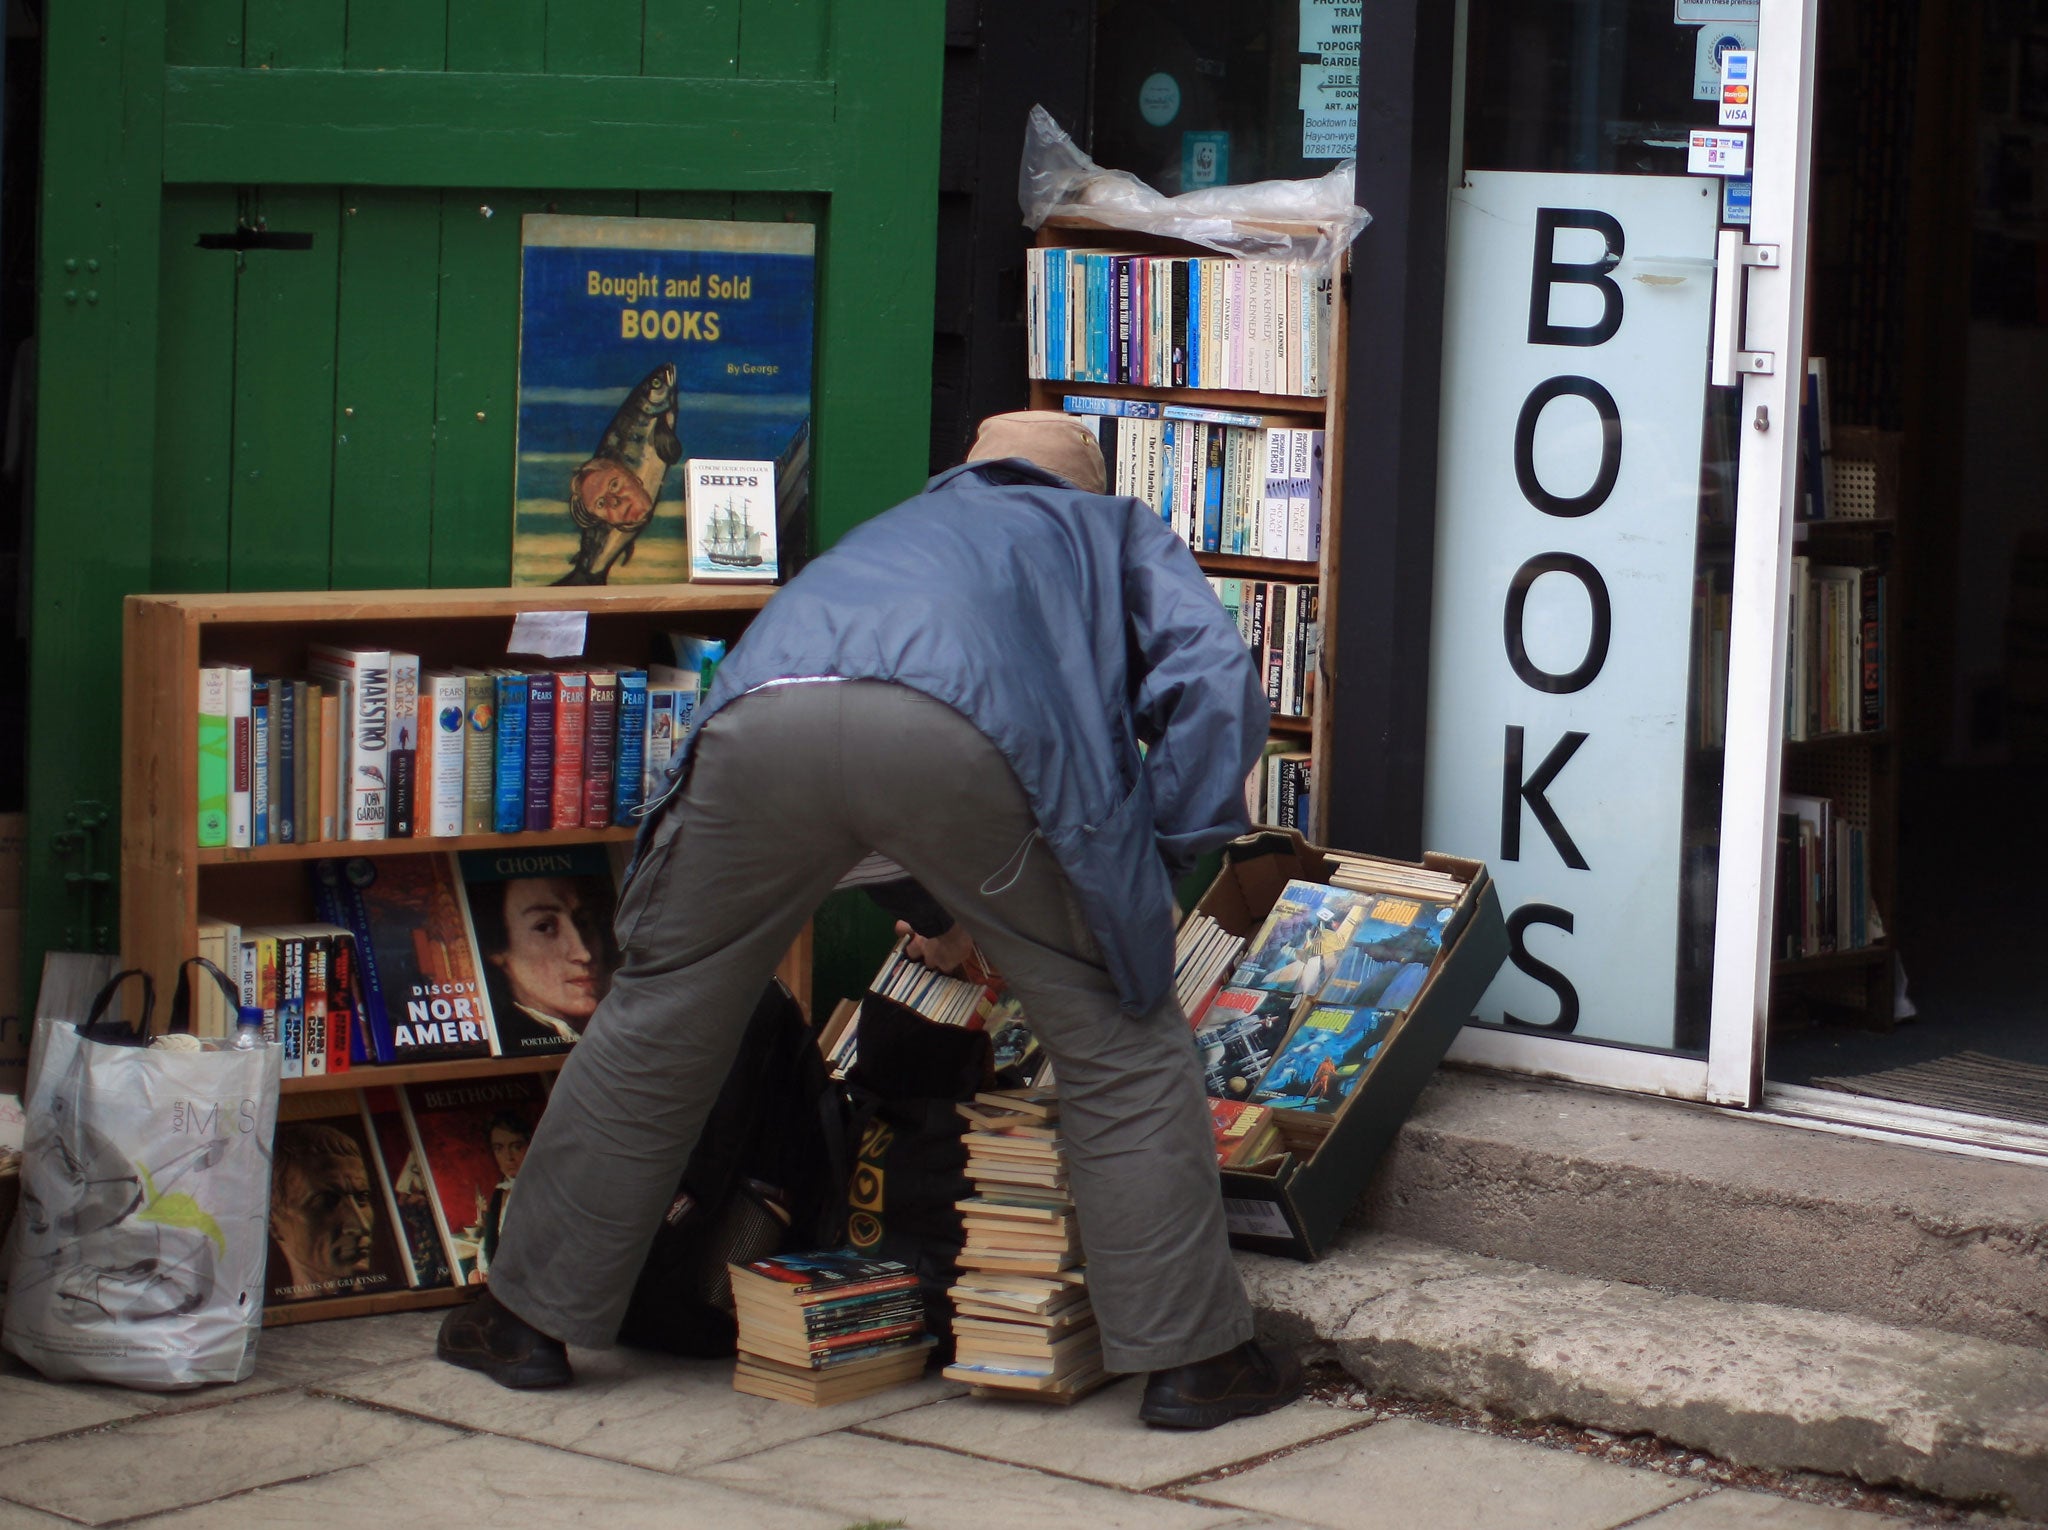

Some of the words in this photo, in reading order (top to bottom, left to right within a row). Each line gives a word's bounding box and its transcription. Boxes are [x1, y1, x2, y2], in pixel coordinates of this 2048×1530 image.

[1327, 75, 1351, 84] SIDE
[1305, 117, 1347, 128] Booktown
[1725, 109, 1747, 119] VISA
[1305, 132, 1355, 143] Hay-on-wye
[588, 271, 658, 303] Bought
[665, 274, 700, 298] and
[707, 274, 751, 300] Sold
[1212, 272, 1220, 296] LENA
[1233, 270, 1241, 292] LENA
[1249, 270, 1258, 295] LENA
[1264, 272, 1272, 296] LENA
[1120, 298, 1129, 310] FOR
[1233, 294, 1241, 332] KENNEDY
[1302, 296, 1310, 331] KENNEDY
[621, 309, 721, 342] BOOKS
[1120, 310, 1129, 324] THE
[1212, 299, 1220, 342] KENNEDY
[1248, 297, 1257, 341] KENNEDY
[1263, 299, 1272, 343] KENNEDY
[1290, 300, 1298, 337] KENNEDY
[1120, 324, 1129, 340] DEAD
[727, 363, 740, 376] By
[743, 363, 779, 376] George
[1210, 438, 1220, 468] Maggie
[1270, 434, 1279, 474] PATTERSON
[1294, 432, 1302, 472] PATTERSON
[700, 475, 758, 487] SHIPS
[1148, 470, 1156, 502] Machine
[1277, 504, 1284, 518] NO
[1300, 504, 1305, 517] NO
[1254, 620, 1261, 628] of
[1502, 207, 1625, 1034] BOOKS
[1252, 629, 1260, 646] Spies
[395, 674, 404, 710] ALLIES
[405, 666, 416, 719] MORTAL
[440, 688, 464, 696] PEARS
[532, 690, 552, 700] PEARS
[560, 691, 584, 702] PEARS
[590, 688, 614, 702] PEARS
[622, 690, 645, 704] PEARS
[1268, 688, 1278, 698] Risk
[358, 668, 388, 752] MAESTRO
[254, 728, 268, 764] family
[240, 771, 248, 789] DAVE
[256, 767, 267, 815] madness
[364, 793, 381, 806] JOHN
[356, 805, 385, 820] GARDNER
[496, 854, 573, 875] CHOPIN
[1370, 899, 1422, 927] analog
[244, 970, 254, 985] JOE
[294, 943, 302, 998] DANCE
[309, 952, 317, 992] ARTIST
[317, 951, 326, 992] MURDER
[412, 981, 476, 996] DISCOV
[1215, 990, 1260, 1014] analog
[1304, 1008, 1354, 1034] analog
[293, 1019, 301, 1059] JOHN
[307, 1016, 316, 1055] CASE
[316, 1016, 325, 1054] JOHN
[394, 1021, 488, 1047] AMERI
[520, 1034, 566, 1046] PORTRAITS
[424, 1081, 530, 1110] BEETHOVEN
[172, 1100, 184, 1134] YOUR
[274, 1283, 321, 1296] PORTRAITS
[323, 1280, 335, 1289] OF
[337, 1273, 388, 1288] GREATNESS
